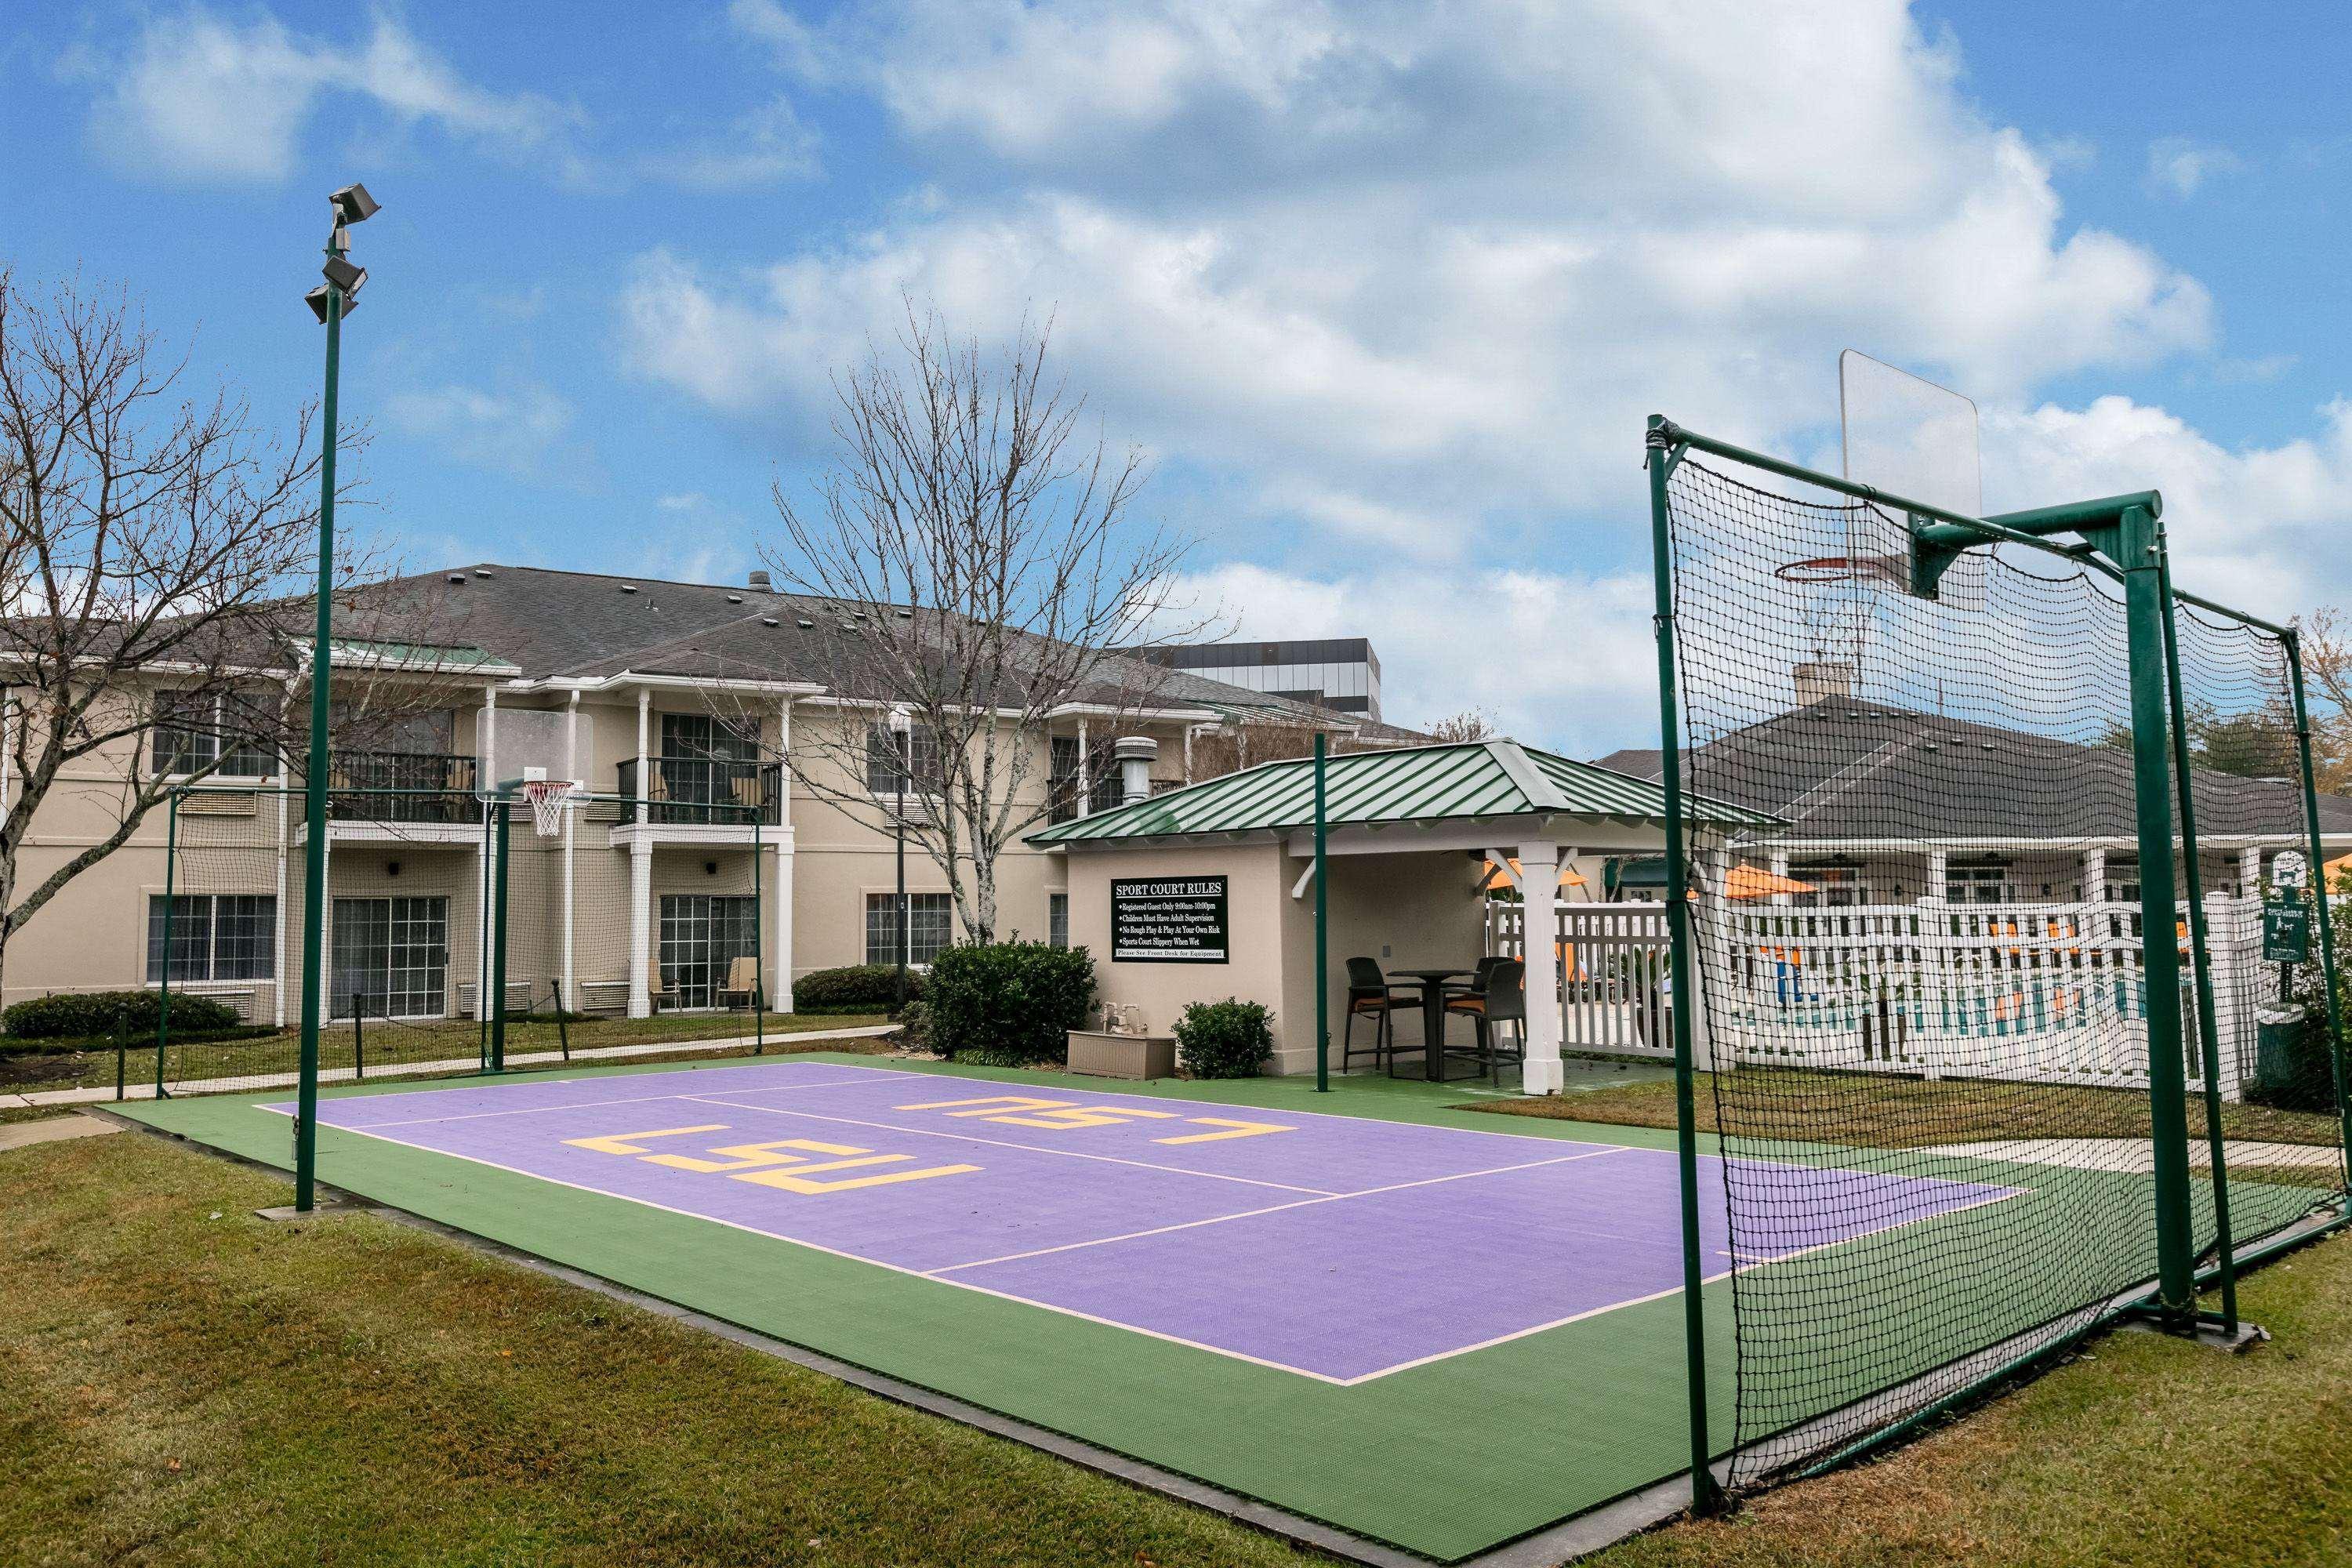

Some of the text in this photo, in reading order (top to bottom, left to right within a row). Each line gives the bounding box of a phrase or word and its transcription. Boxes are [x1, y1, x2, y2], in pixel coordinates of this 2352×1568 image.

[1116, 882, 1221, 895] SPORT COURT RULES
[1122, 902, 1146, 913] Registered
[1162, 902, 1174, 912] Only
[1156, 913, 1170, 922] Have
[1170, 913, 1184, 922] Adult
[1185, 913, 1214, 924] Supervision
[1130, 926, 1145, 935] Rough
[1145, 925, 1157, 935] Play
[1157, 925, 1163, 934] &
[1163, 925, 1174, 935] Play
[1175, 925, 1181, 934] At
[1181, 925, 1195, 934] Your
[1195, 925, 1207, 934] Own
[1208, 925, 1220, 934] Risk
[1122, 937, 1200, 947] Sports Court Slippery When Wet
[560, 1124, 986, 1195] LSU
